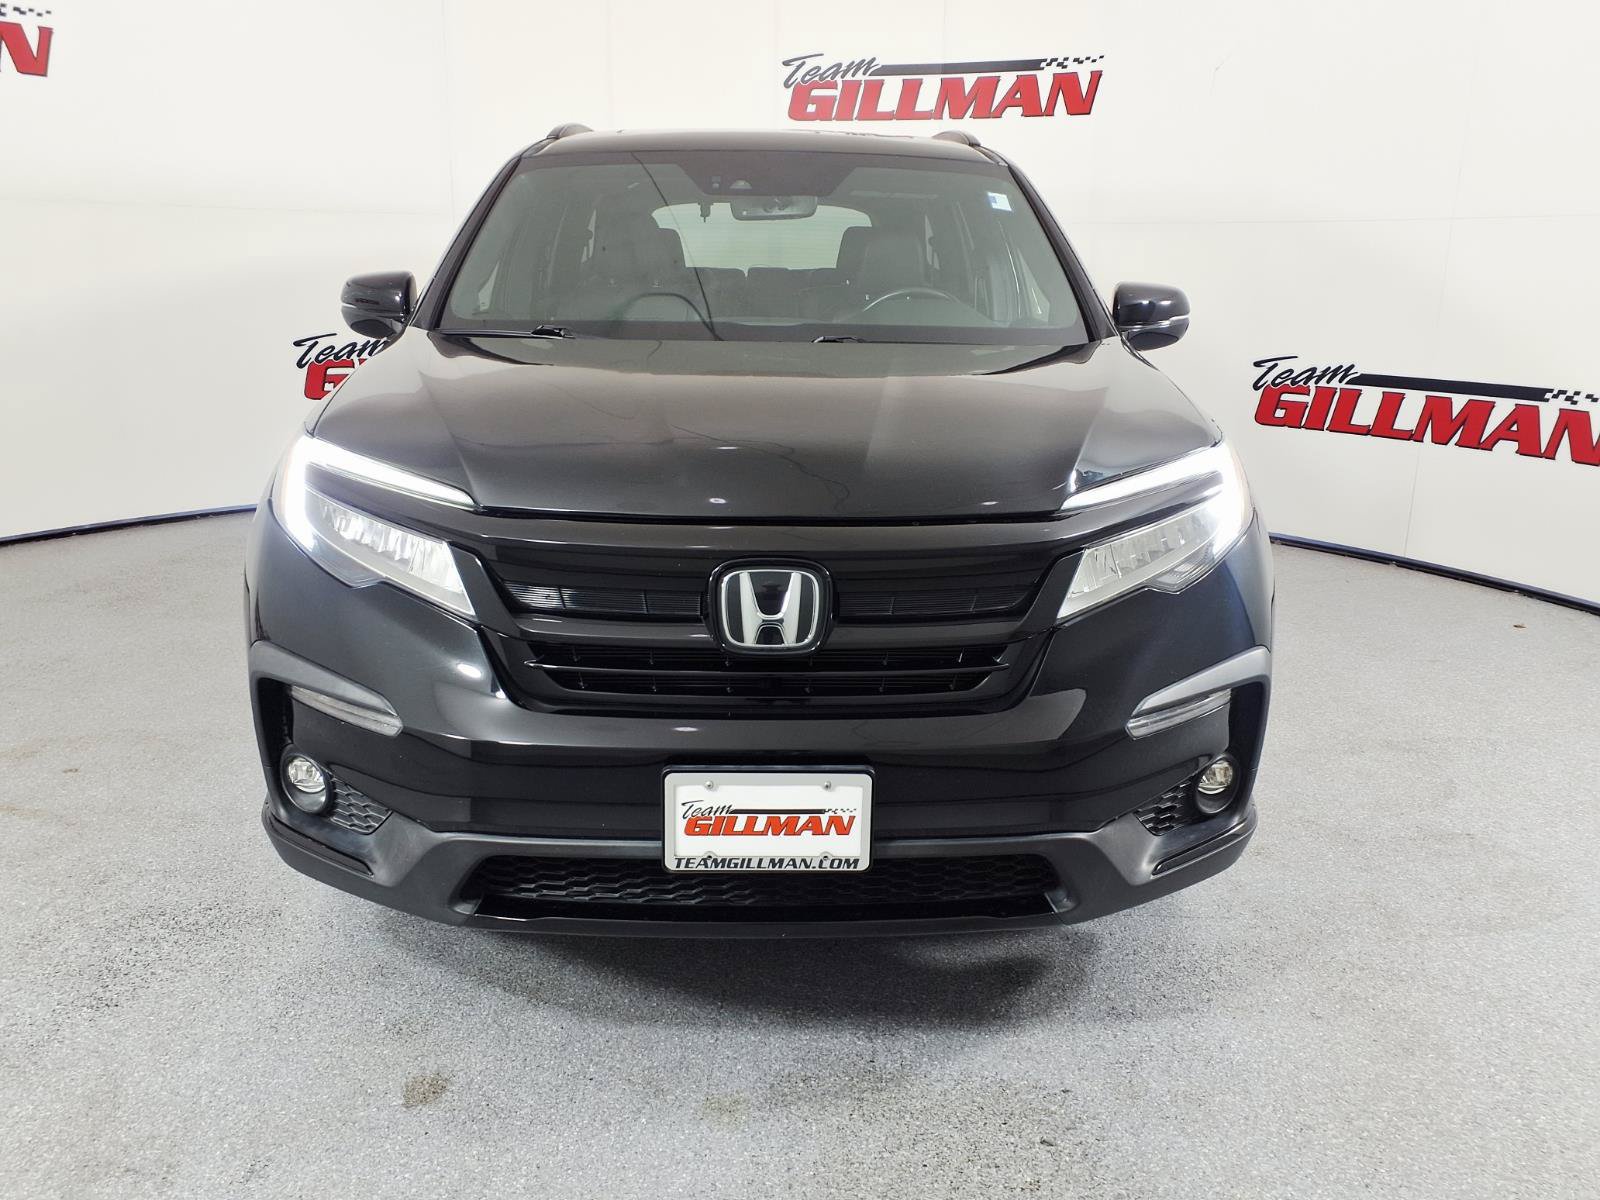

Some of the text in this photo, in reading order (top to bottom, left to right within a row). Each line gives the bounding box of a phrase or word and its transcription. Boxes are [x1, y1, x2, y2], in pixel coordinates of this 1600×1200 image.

[782, 53, 880, 89] Team
[788, 70, 1103, 121] GILLMAN
[293, 333, 390, 369] Team
[1253, 356, 1358, 391] Team
[1254, 384, 1600, 467] GILLMAN
[681, 800, 734, 820] Team
[684, 815, 856, 836] GILLMAN
[674, 857, 860, 870] TEAMGILLMAN.COM
